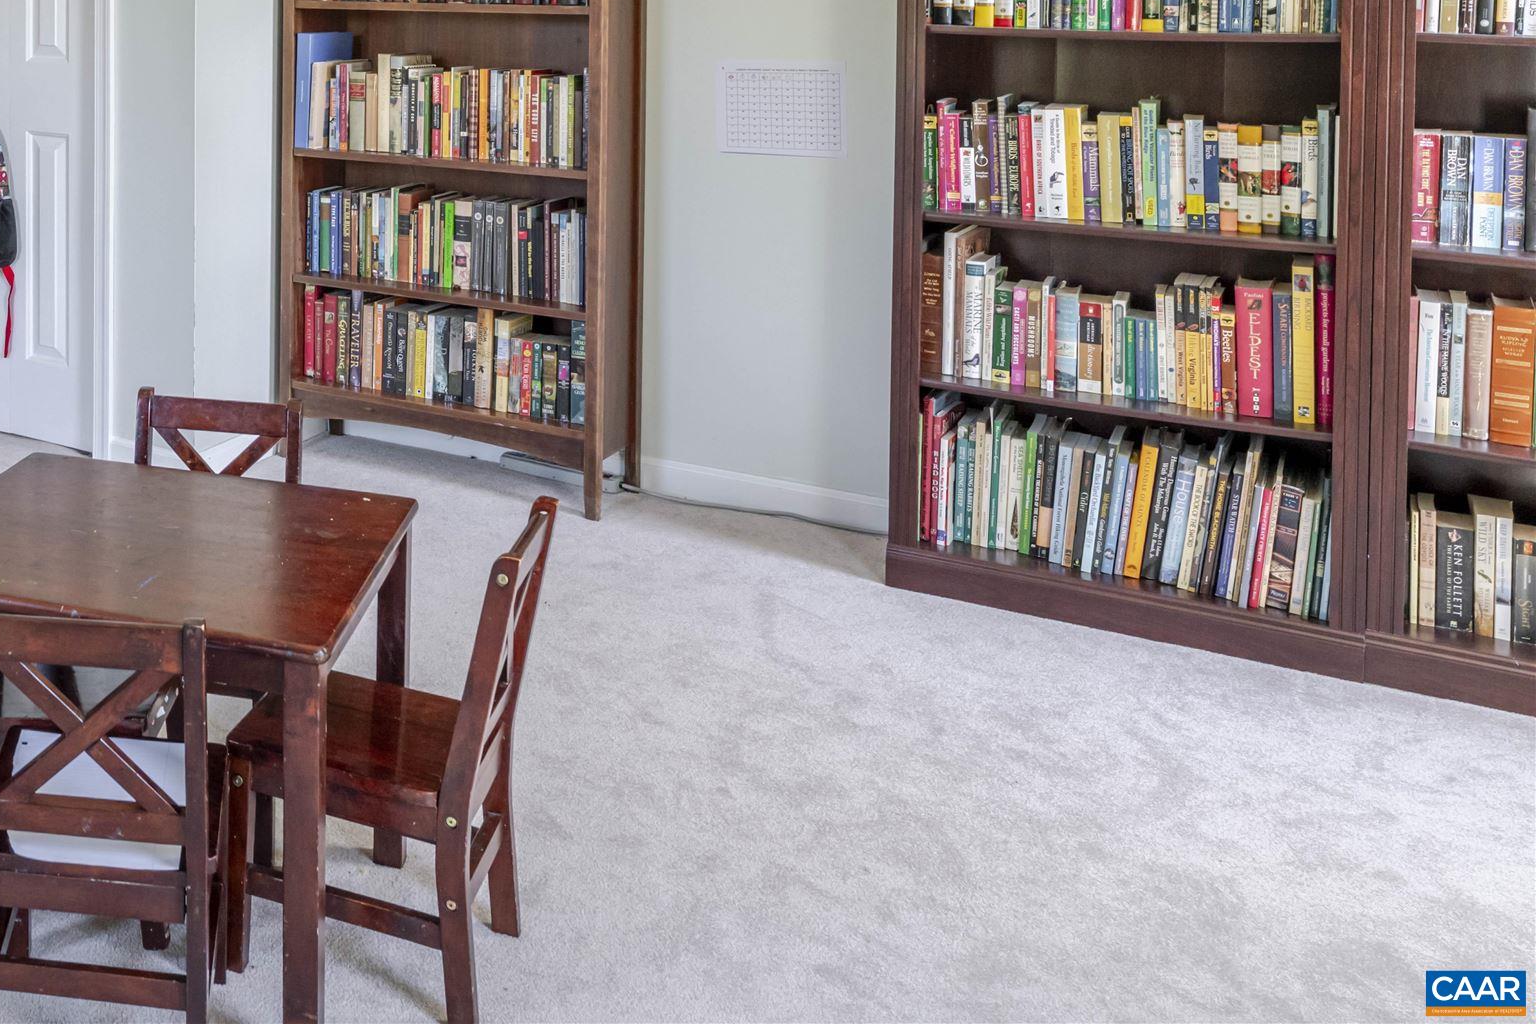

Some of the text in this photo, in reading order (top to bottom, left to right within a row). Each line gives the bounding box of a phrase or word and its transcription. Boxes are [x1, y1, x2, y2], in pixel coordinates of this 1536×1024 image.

[1008, 140, 1019, 191] BIRDS EUROPE
[1089, 146, 1099, 191] Mammals
[1307, 139, 1317, 161] Birds
[1447, 149, 1457, 186] BROWN
[1457, 157, 1467, 179] DAN
[1483, 148, 1495, 191] DAN BROWN
[1508, 150, 1524, 211] DAN BROWN
[965, 291, 973, 333] MAMMALS
[973, 292, 982, 333] MARINE
[1321, 293, 1329, 317] projects
[350, 311, 360, 368] TRAVELER
[1027, 316, 1035, 357] MUSHROOMS
[1222, 330, 1232, 363] Beetles
[1248, 312, 1261, 379] ELDEST
[1084, 344, 1095, 379] dictionary
[1188, 359, 1196, 385] Virginia
[1321, 347, 1329, 371] gardens
[1440, 372, 1448, 395] WOODS
[1080, 492, 1088, 512] Cider
[1228, 512, 1237, 533] WATCH
[1478, 521, 1488, 563] WILD SKY
[1453, 544, 1463, 617] KEN FOLLETT
